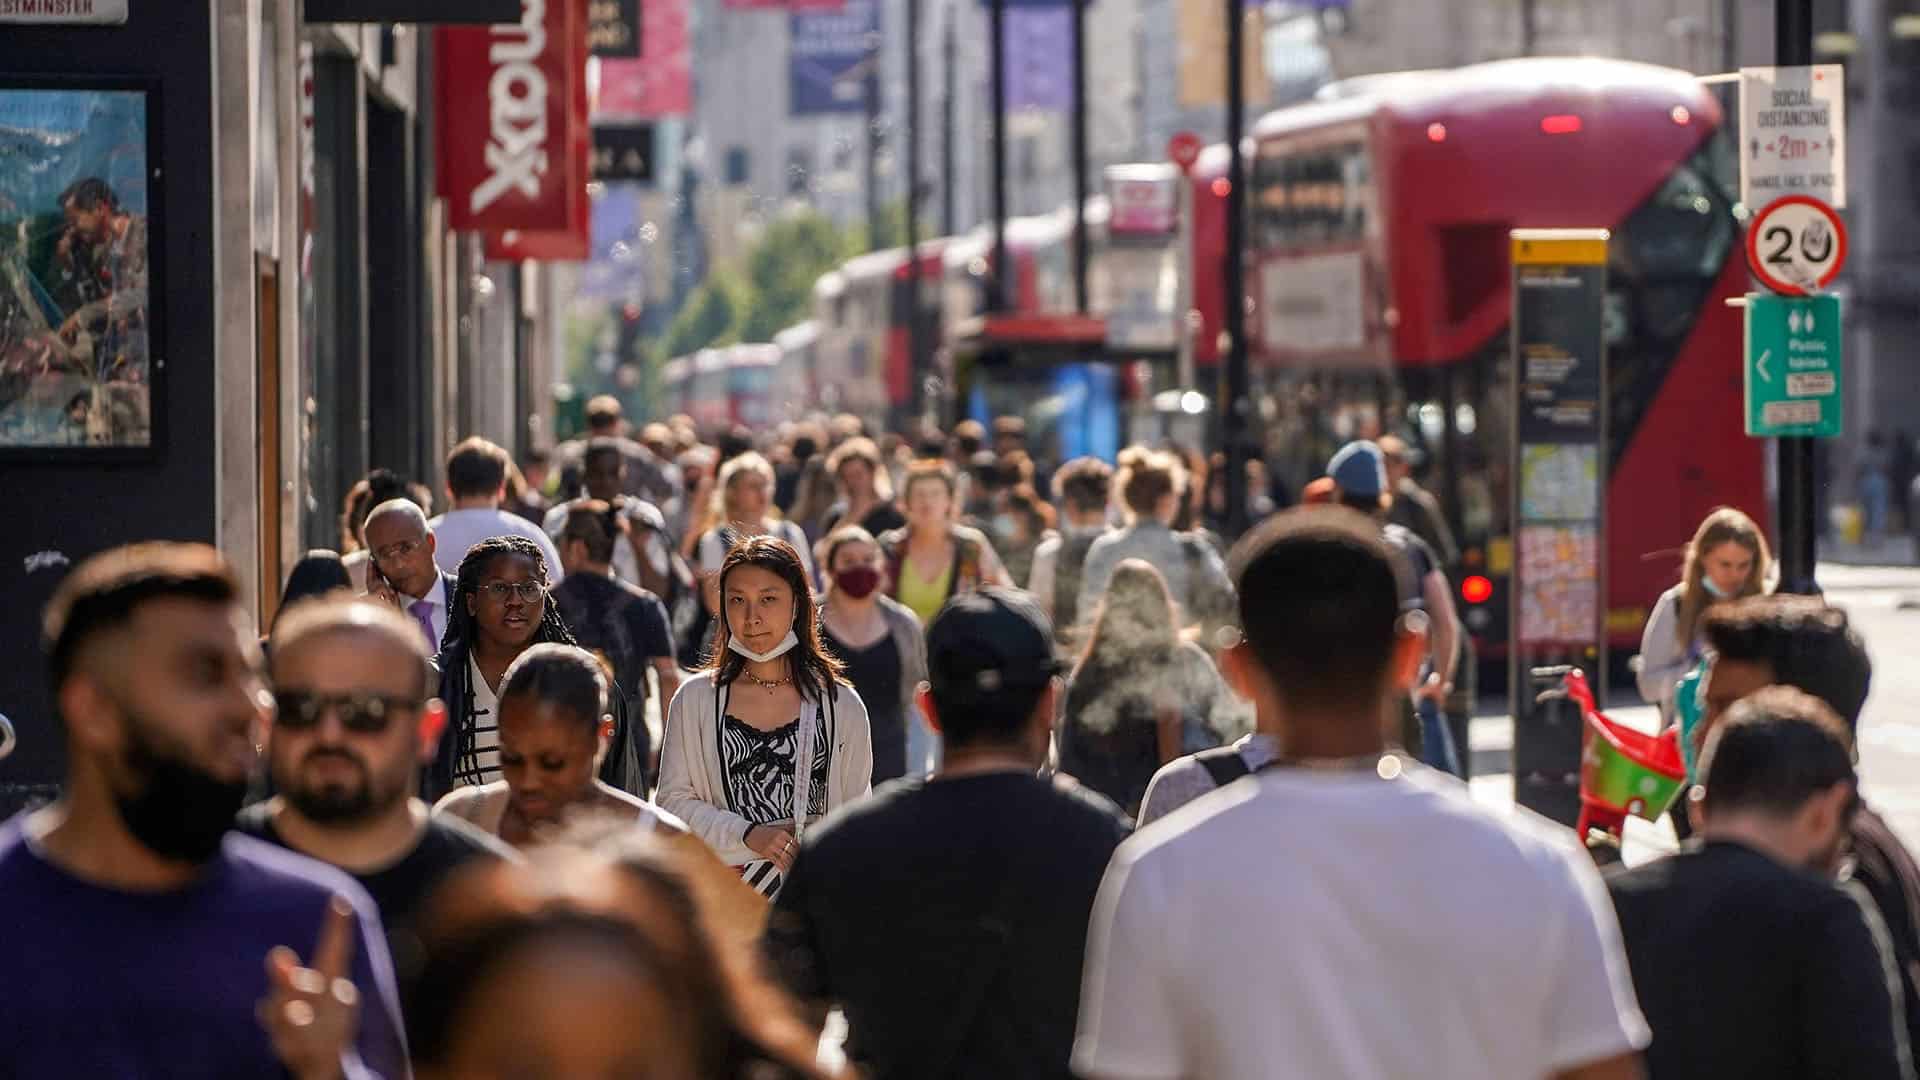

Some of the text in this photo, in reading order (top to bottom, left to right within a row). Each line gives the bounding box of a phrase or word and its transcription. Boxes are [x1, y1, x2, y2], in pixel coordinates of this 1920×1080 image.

[1772, 89, 1812, 107] SOCIAL
[1757, 109, 1828, 128] DISTANCING
[1778, 134, 1808, 160] 2m
[1765, 225, 1832, 264] 20
